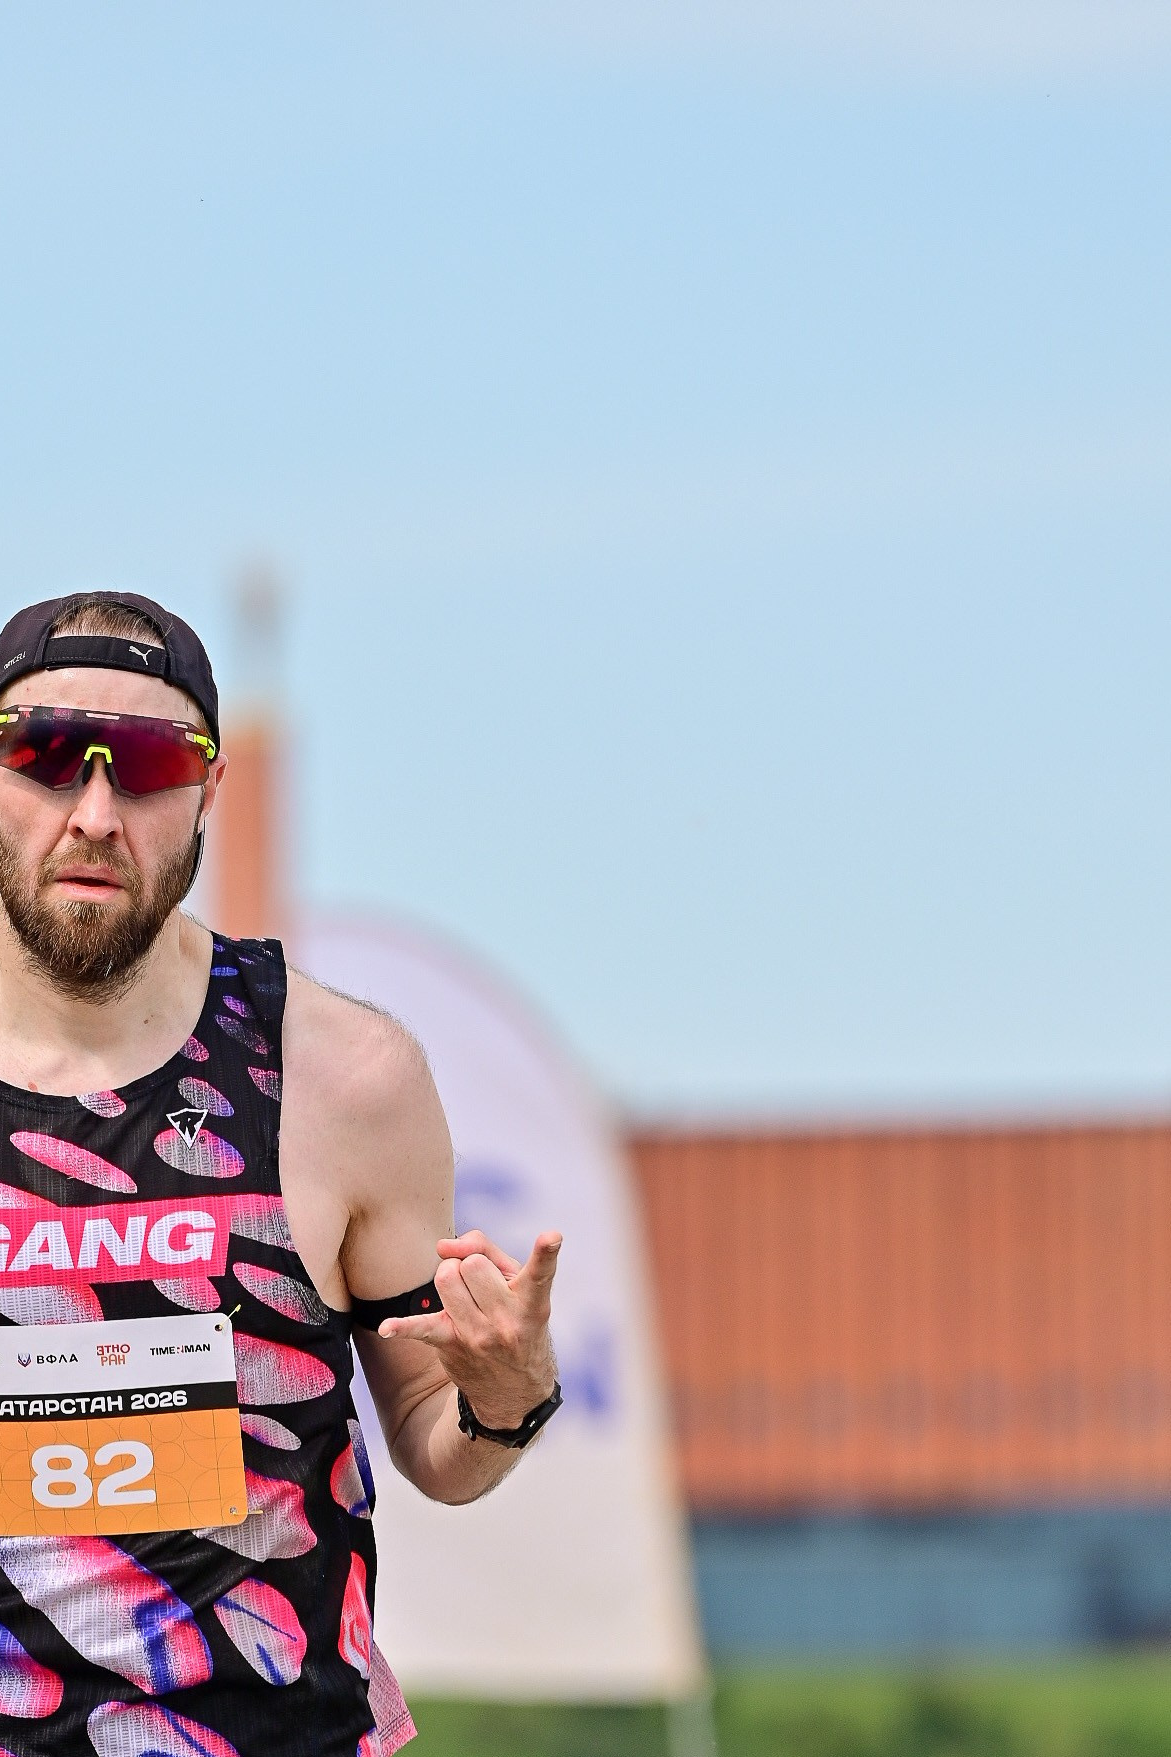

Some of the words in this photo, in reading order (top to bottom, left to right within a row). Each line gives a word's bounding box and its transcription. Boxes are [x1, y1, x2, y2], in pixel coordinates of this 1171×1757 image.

[96, 1343, 131, 1356] ЭТНО
[36, 1353, 79, 1365] ВФЛА
[130, 1389, 188, 1411] 2026
[31, 1440, 157, 1509] 82
